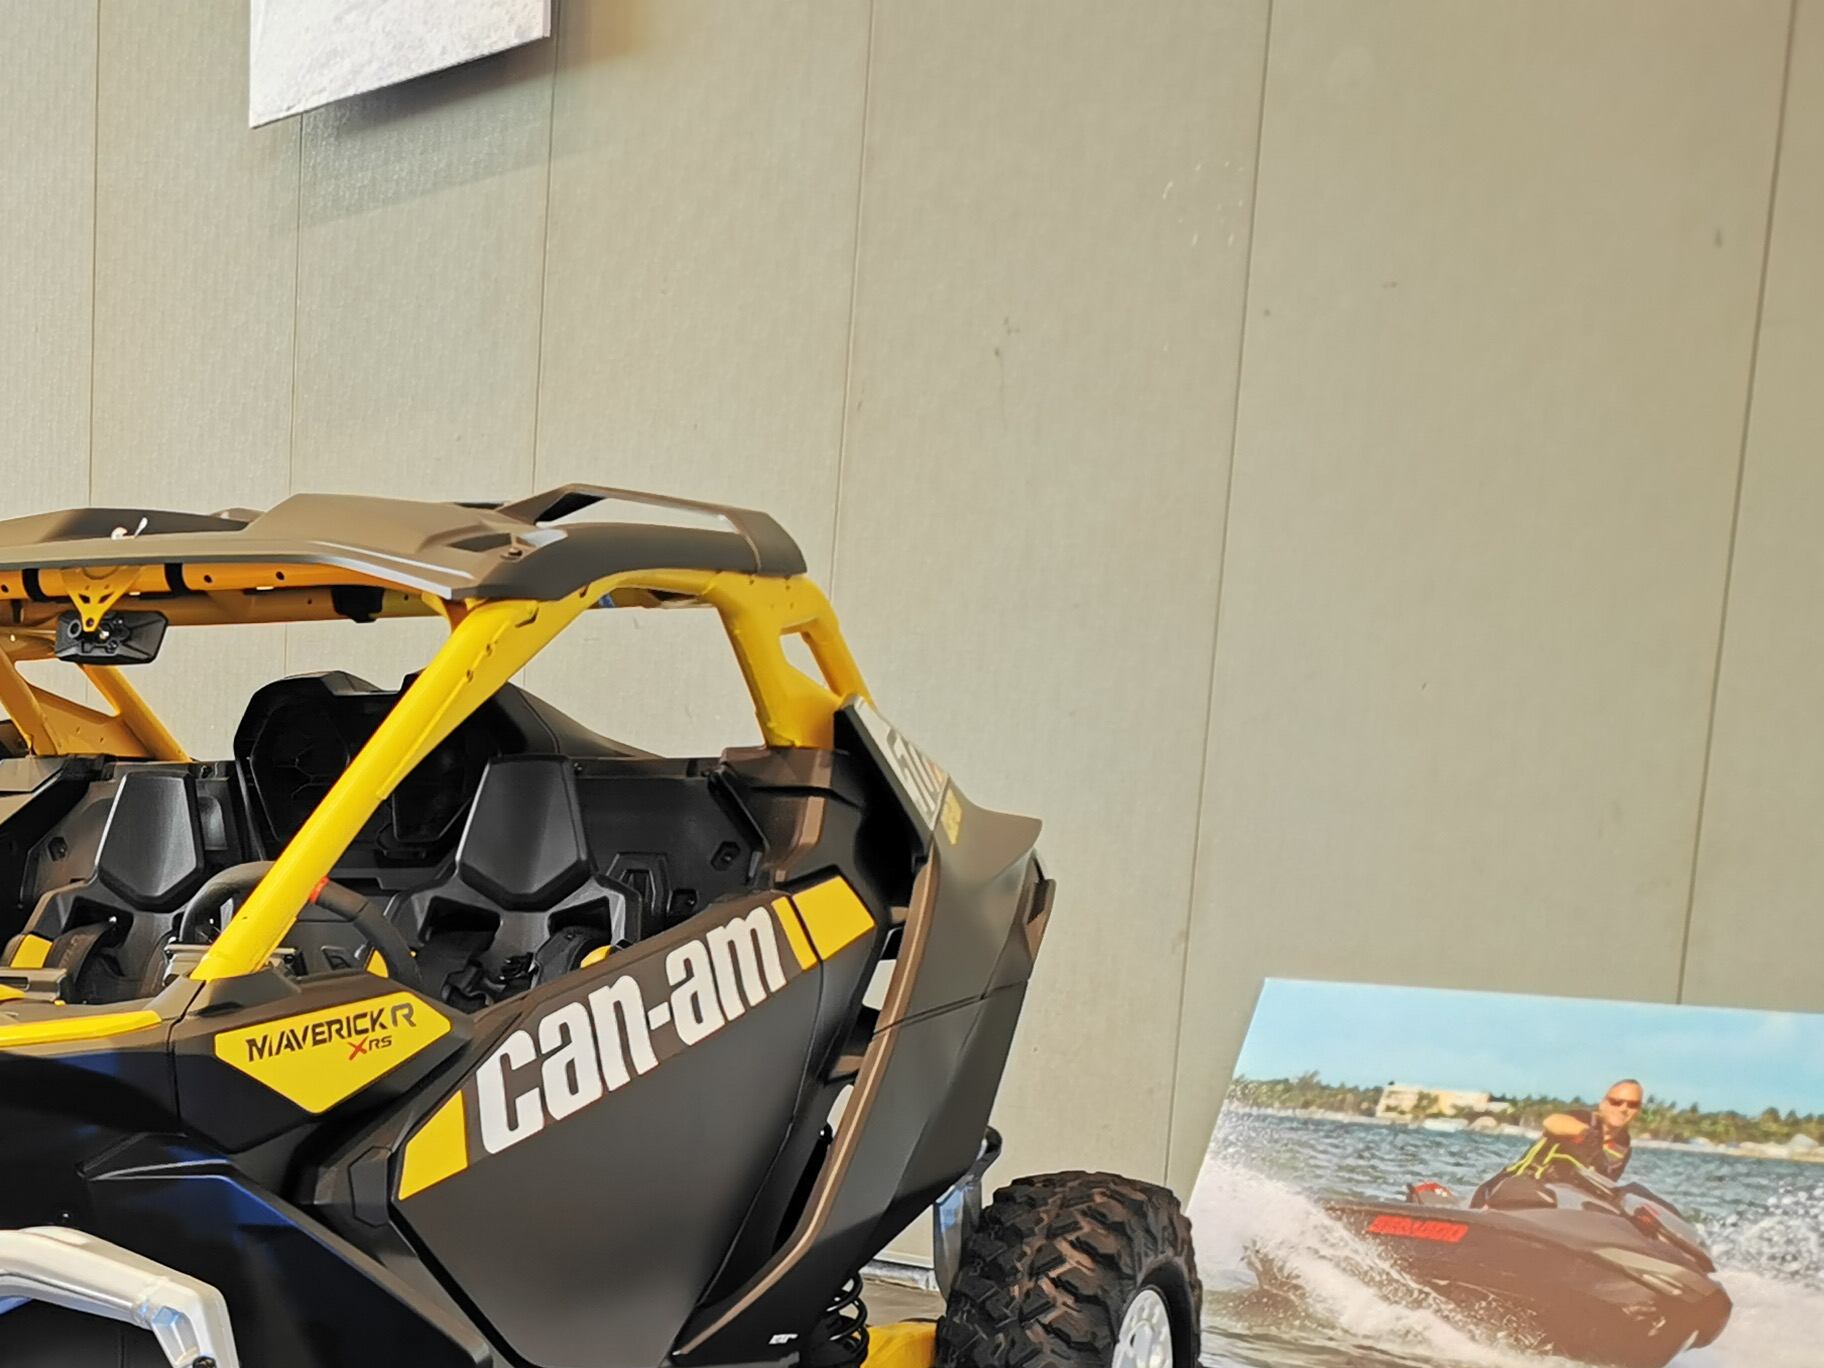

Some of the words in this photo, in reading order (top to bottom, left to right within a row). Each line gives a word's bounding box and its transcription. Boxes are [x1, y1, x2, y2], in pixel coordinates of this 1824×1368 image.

[245, 1008, 388, 1063] MAVERICK
[390, 1002, 417, 1028] R
[475, 906, 787, 1154] can-am
